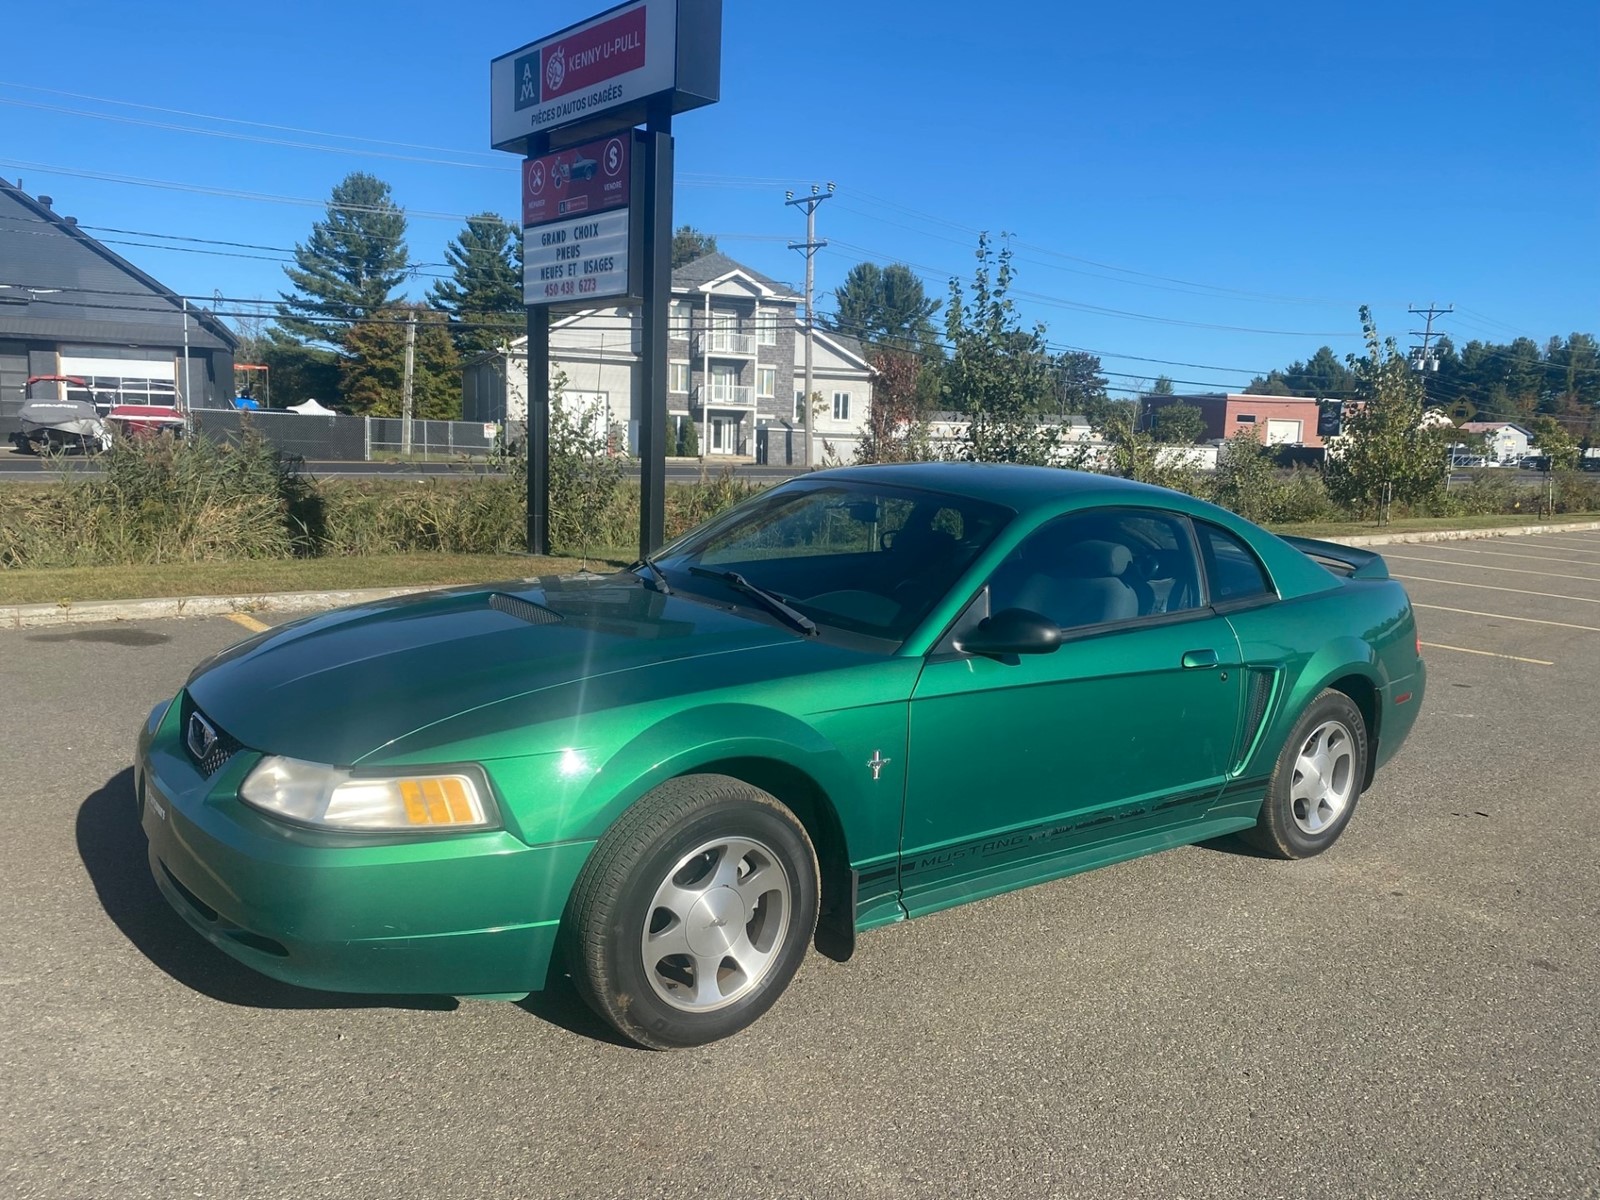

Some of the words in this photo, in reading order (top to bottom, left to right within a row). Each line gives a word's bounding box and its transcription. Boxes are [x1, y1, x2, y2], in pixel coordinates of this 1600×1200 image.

[569, 45, 602, 72] KENNY
[603, 31, 641, 59] U-PULL
[556, 97, 586, 118] D'AUTOS
[587, 84, 623, 108] USAGÉES
[541, 229, 567, 246] GRAND
[573, 223, 599, 241] CHOIX
[556, 244, 581, 261] PNEUS
[540, 265, 564, 280] NEUFS
[568, 263, 577, 277] ET
[584, 257, 614, 274] USAGES
[544, 283, 559, 297] 450
[578, 278, 597, 293] 6273
[921, 838, 1023, 867] MUSTANG
